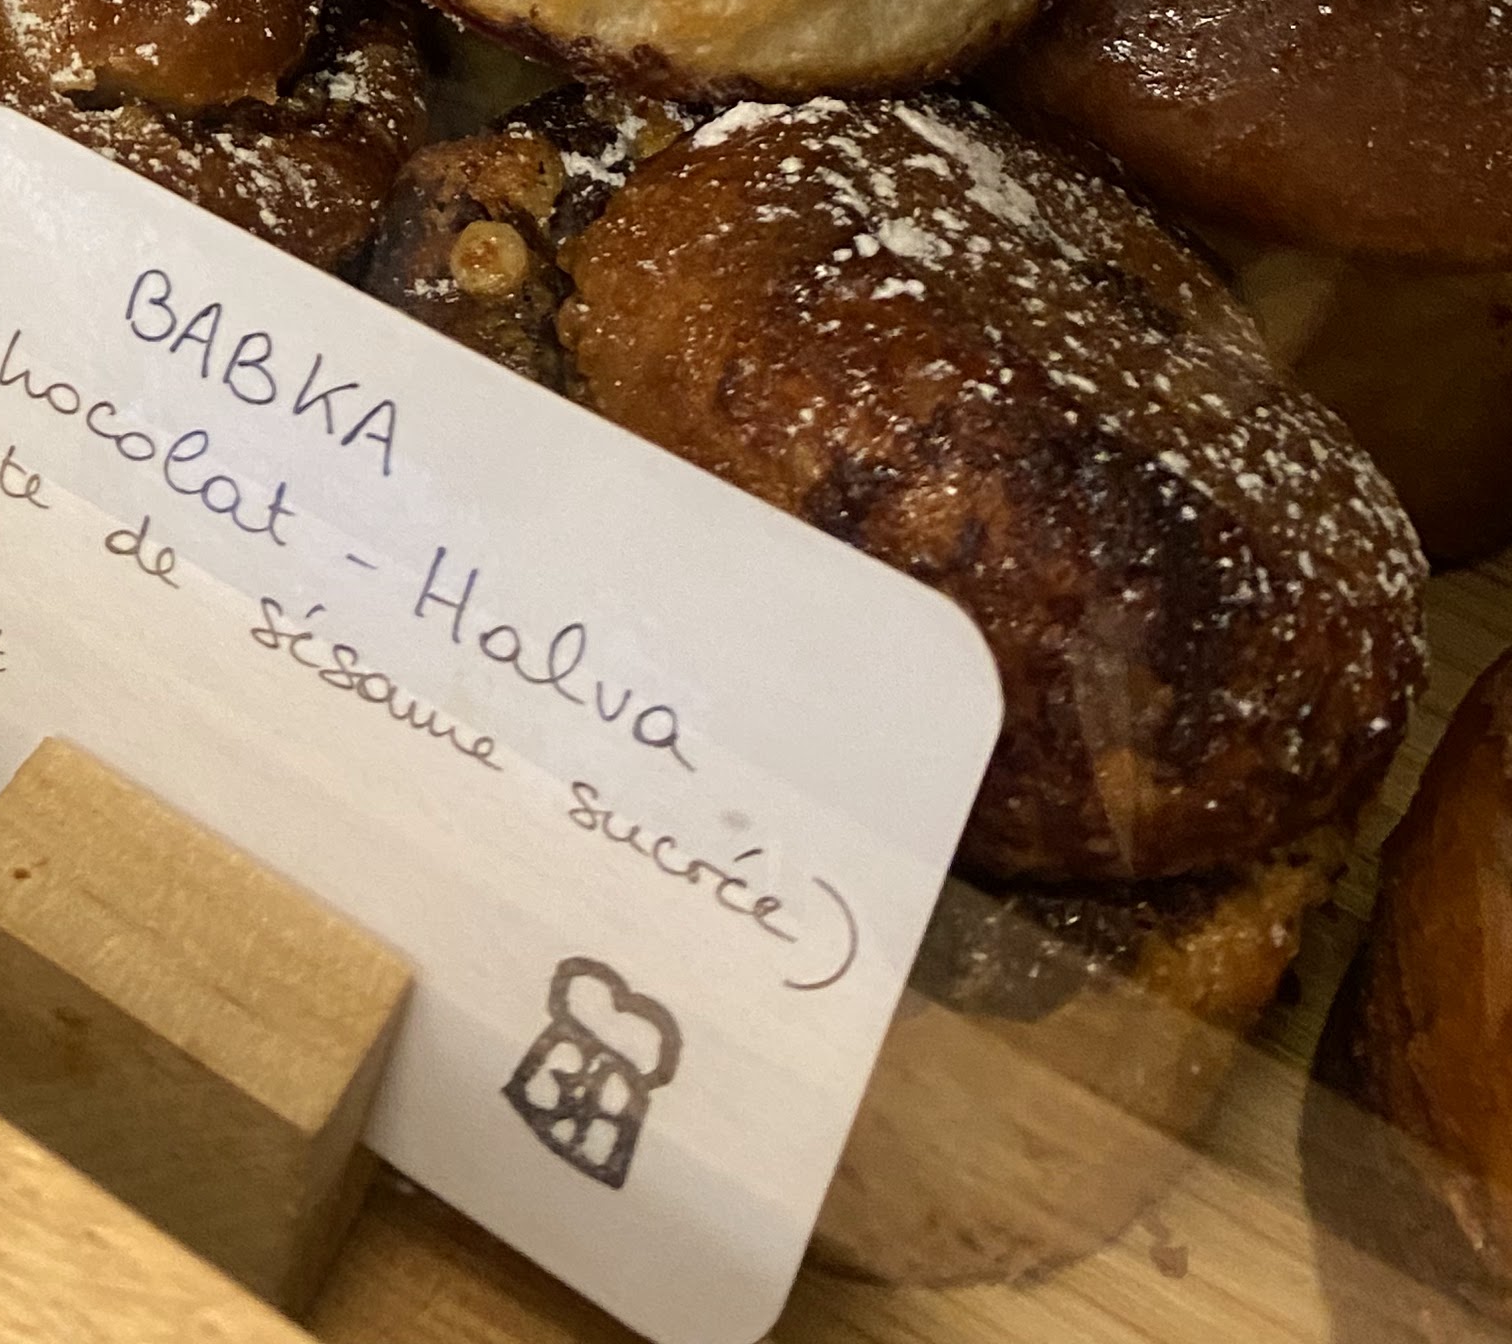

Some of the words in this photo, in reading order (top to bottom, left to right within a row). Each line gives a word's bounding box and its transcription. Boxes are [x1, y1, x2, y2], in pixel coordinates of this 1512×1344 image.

[124, 268, 398, 477] BABKA
[104, 514, 181, 589] de
[250, 596, 504, 772] sésame
[414, 546, 697, 773] Halva
